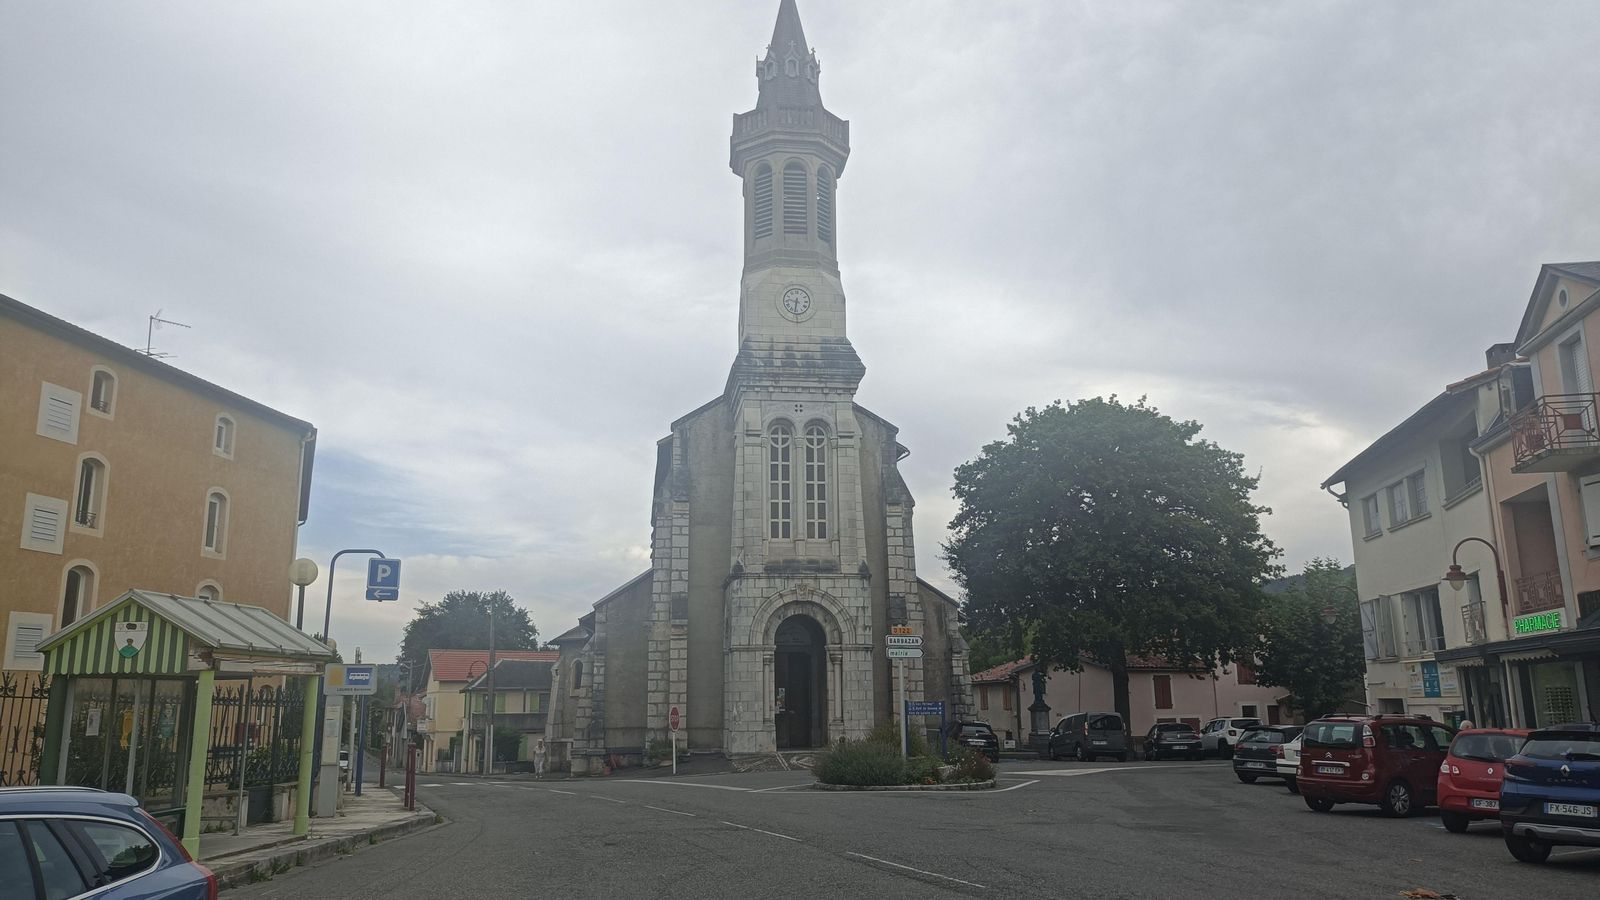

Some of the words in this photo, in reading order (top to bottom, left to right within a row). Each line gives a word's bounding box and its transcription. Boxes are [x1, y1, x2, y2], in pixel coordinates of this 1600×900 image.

[377, 564, 391, 582] P
[1514, 612, 1560, 633] PHARMACIE
[1549, 804, 1592, 815] FX-546-JS
